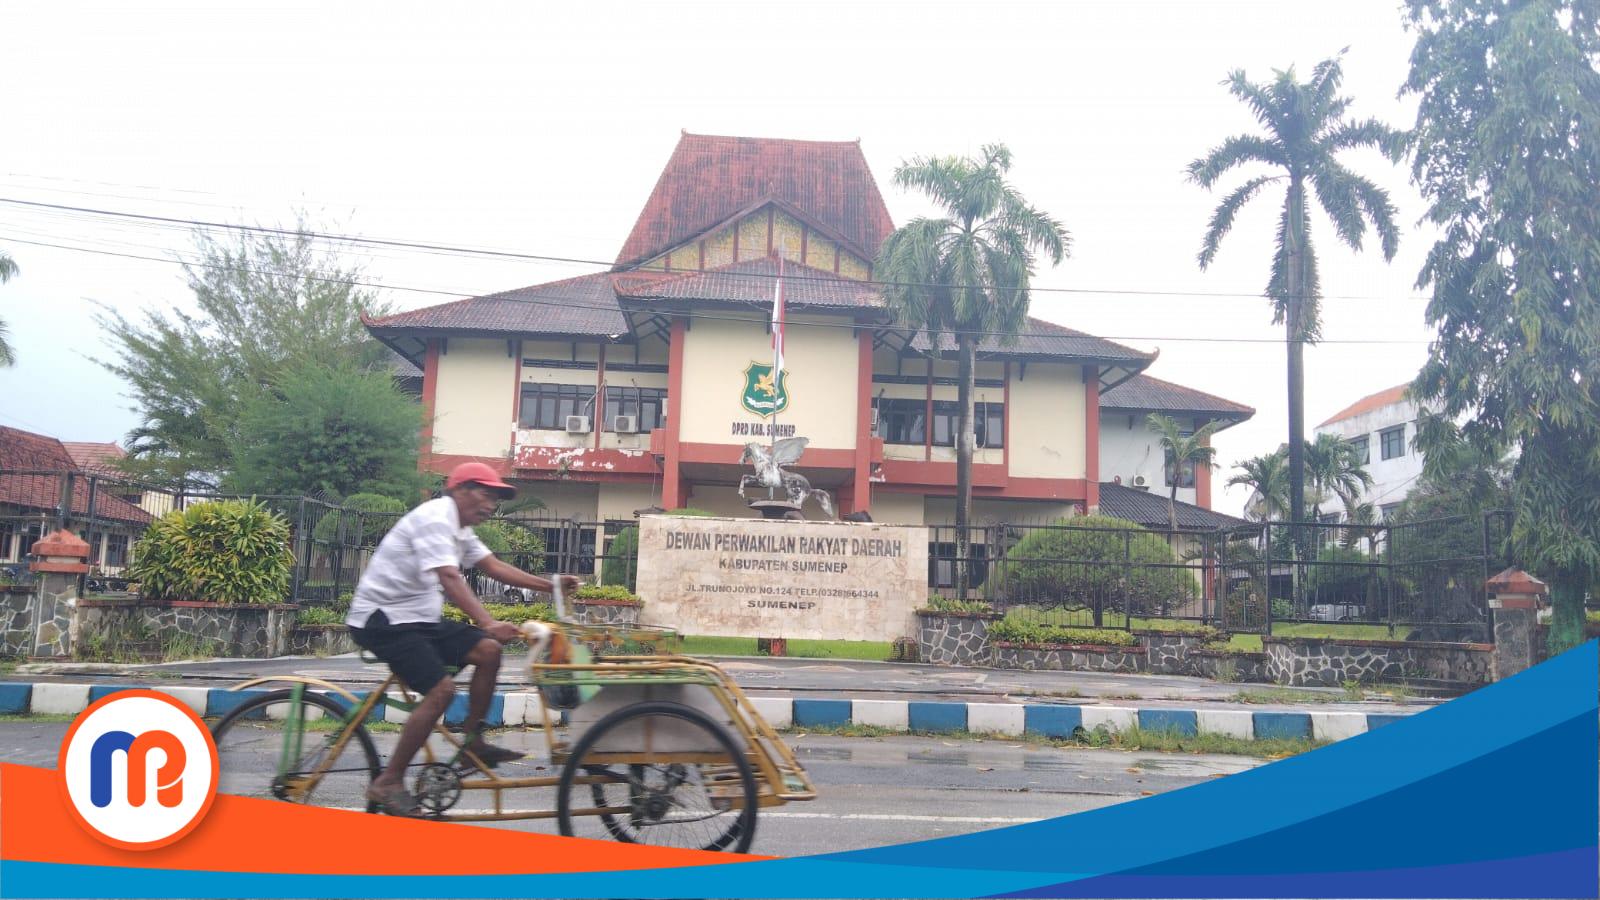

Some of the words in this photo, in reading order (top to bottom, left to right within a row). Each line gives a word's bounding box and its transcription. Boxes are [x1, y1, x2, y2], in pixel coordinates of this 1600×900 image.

[732, 422, 749, 435] DPRD
[751, 423, 765, 436] KAB.
[666, 531, 711, 550] DEWAN
[714, 533, 796, 553] PERWAKILAN
[799, 536, 848, 555] RAKYAT
[852, 538, 902, 557] DAERAH
[719, 558, 788, 571] KABUPATEN
[792, 560, 848, 573] SUMENEP
[747, 600, 816, 609] SUMENEP
